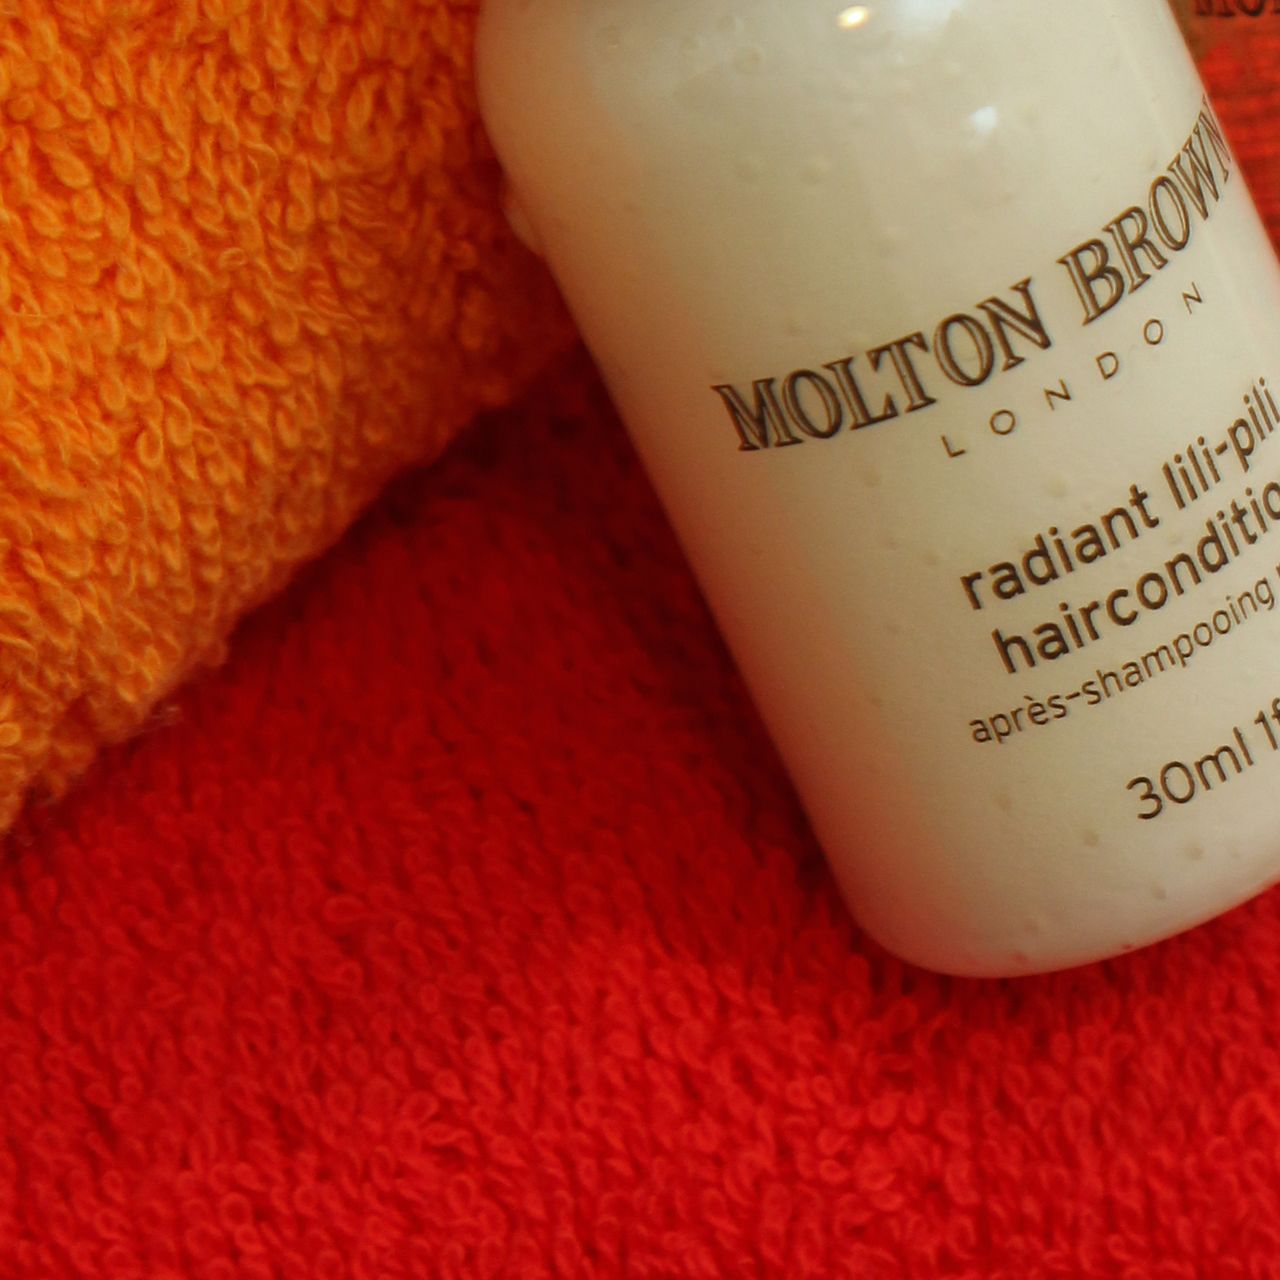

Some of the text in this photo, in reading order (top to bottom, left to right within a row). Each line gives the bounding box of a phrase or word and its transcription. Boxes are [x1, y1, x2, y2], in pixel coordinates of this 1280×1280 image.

[710, 94, 1232, 452] MOLTON BROWN
[941, 280, 1204, 459] LONDON
[959, 483, 1161, 611] radiant
[968, 576, 1278, 745] après-shampooing
[1125, 725, 1255, 820] 30ml
